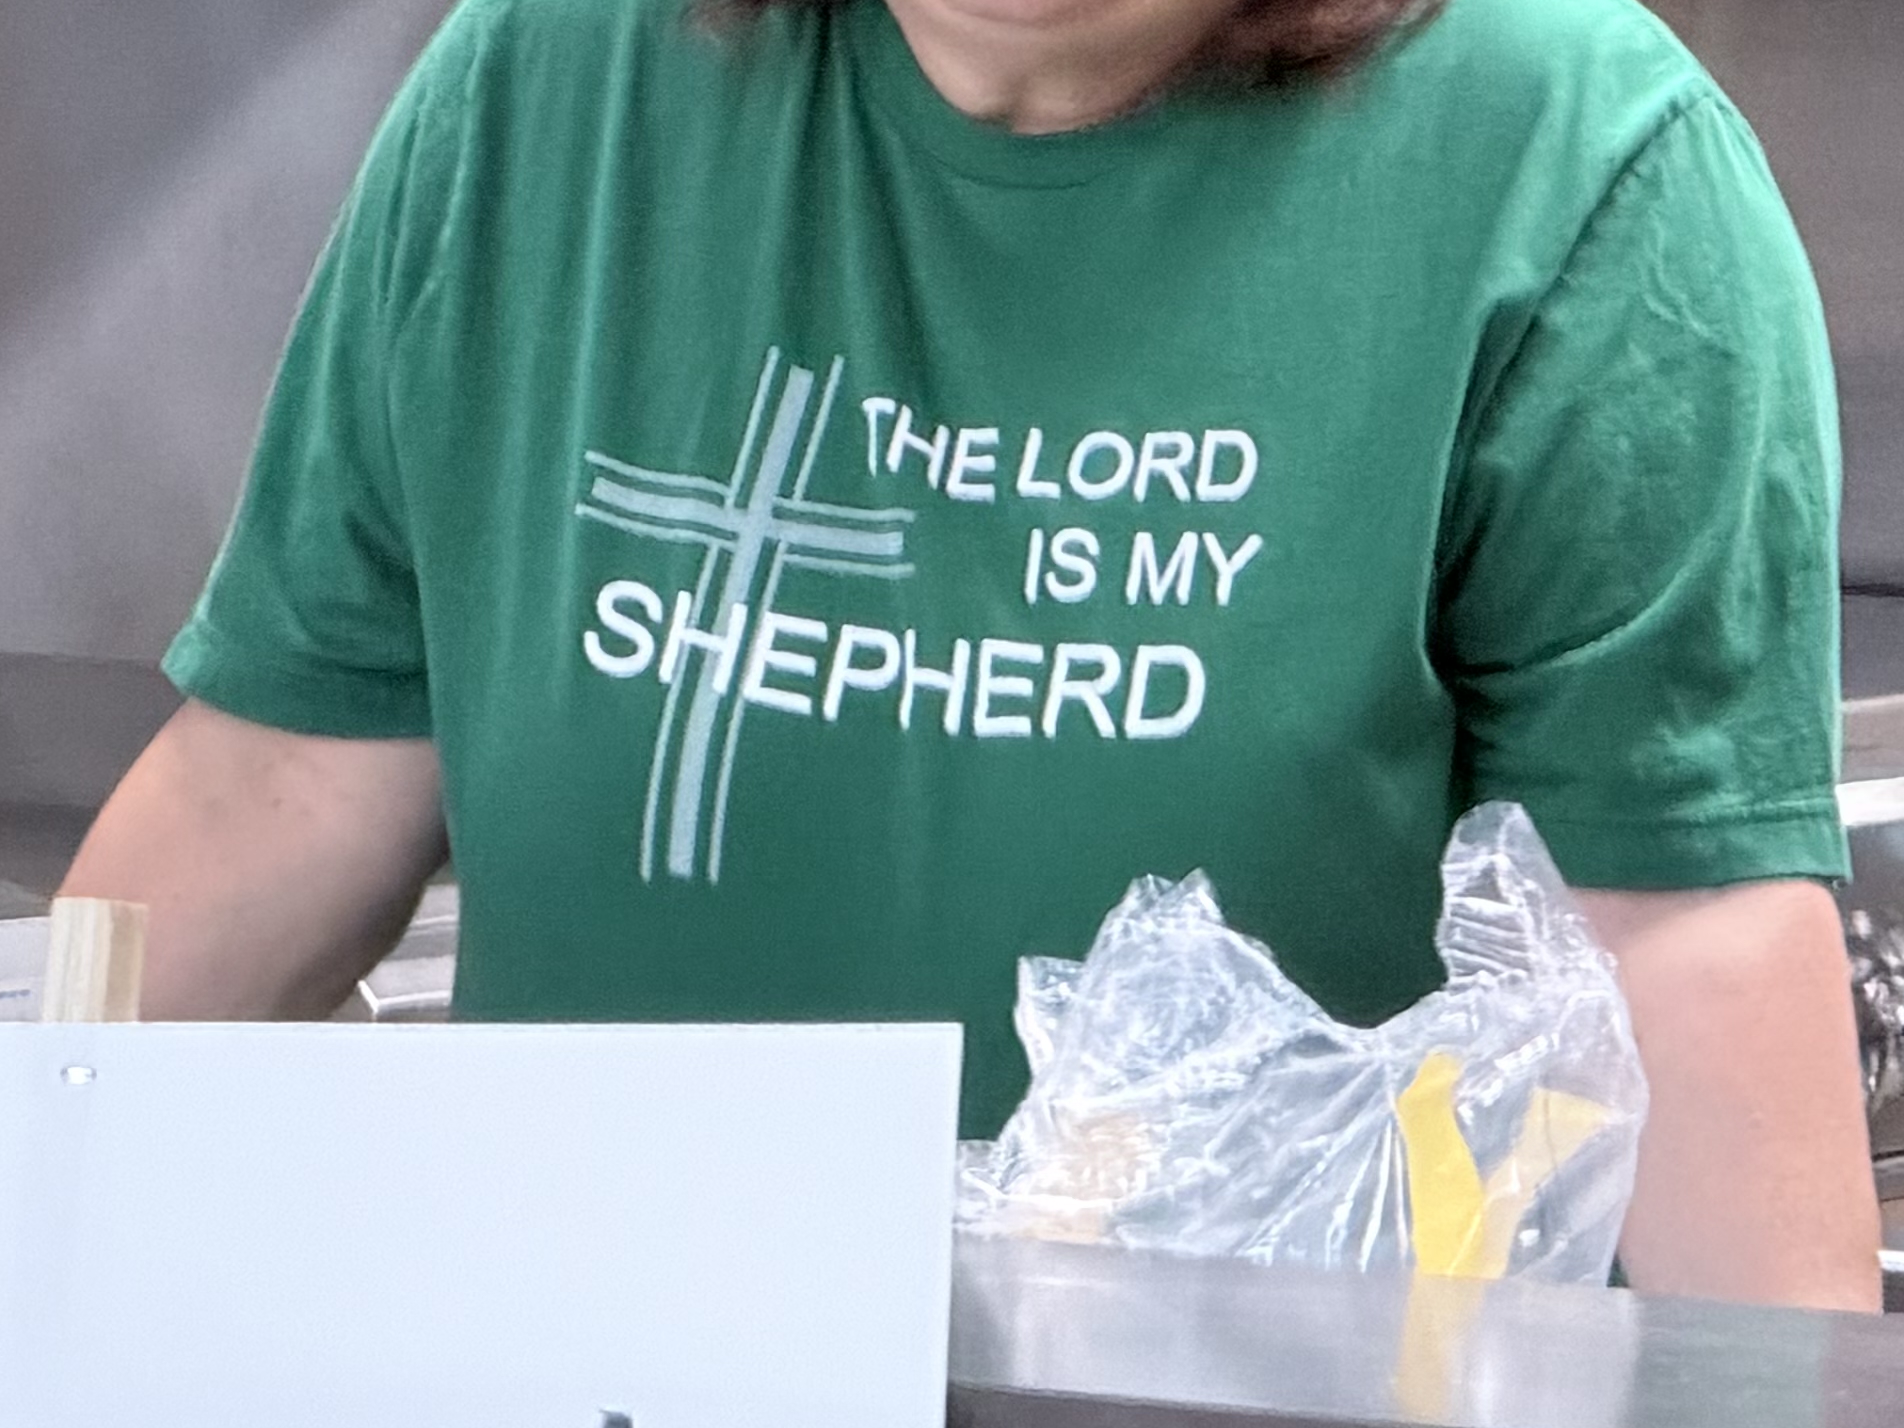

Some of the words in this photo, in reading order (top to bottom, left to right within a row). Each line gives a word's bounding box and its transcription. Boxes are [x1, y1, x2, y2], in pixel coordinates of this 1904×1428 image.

[862, 396, 1000, 503] THE
[1017, 428, 1259, 503] LORD
[1025, 528, 1100, 606] IS
[1126, 530, 1264, 607] MY
[582, 578, 1207, 741] SHEPHERD
